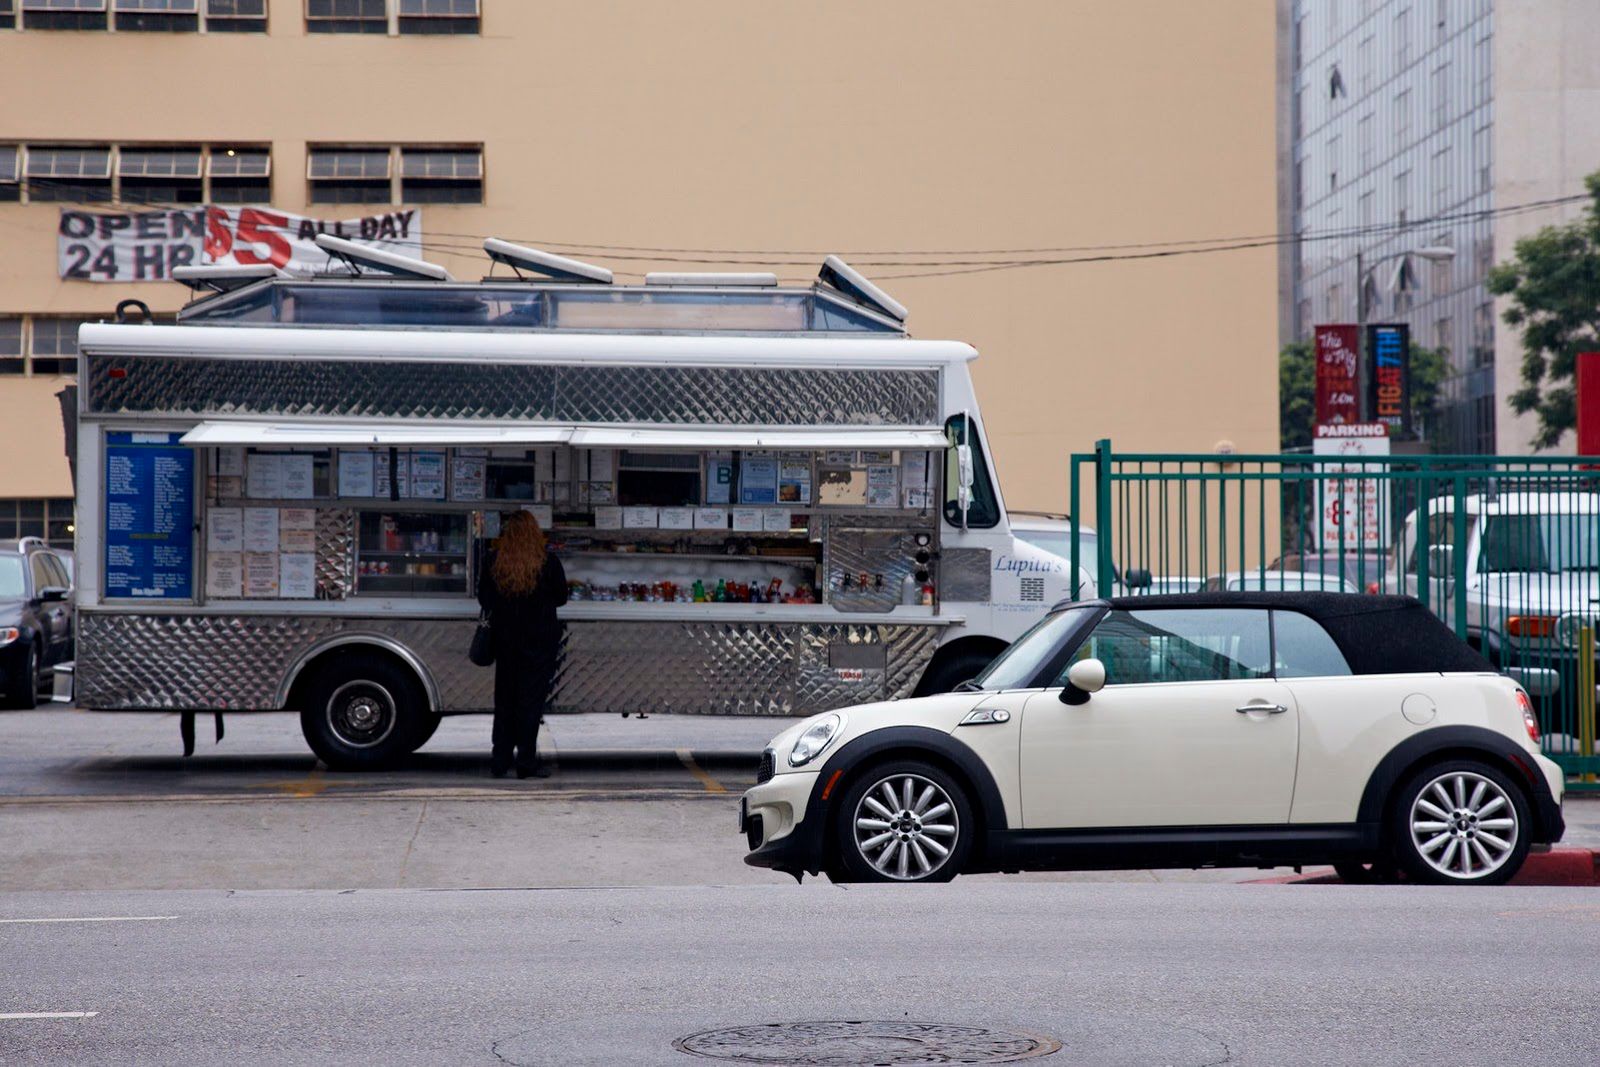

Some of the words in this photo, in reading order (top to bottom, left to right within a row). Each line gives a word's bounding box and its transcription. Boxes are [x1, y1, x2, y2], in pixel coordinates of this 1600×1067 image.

[60, 212, 205, 239] OPEN
[204, 207, 291, 269] $5
[360, 210, 414, 240] DAY
[65, 244, 118, 279] 24
[1318, 424, 1385, 437] PARKING
[994, 555, 1062, 577] Lupita's
